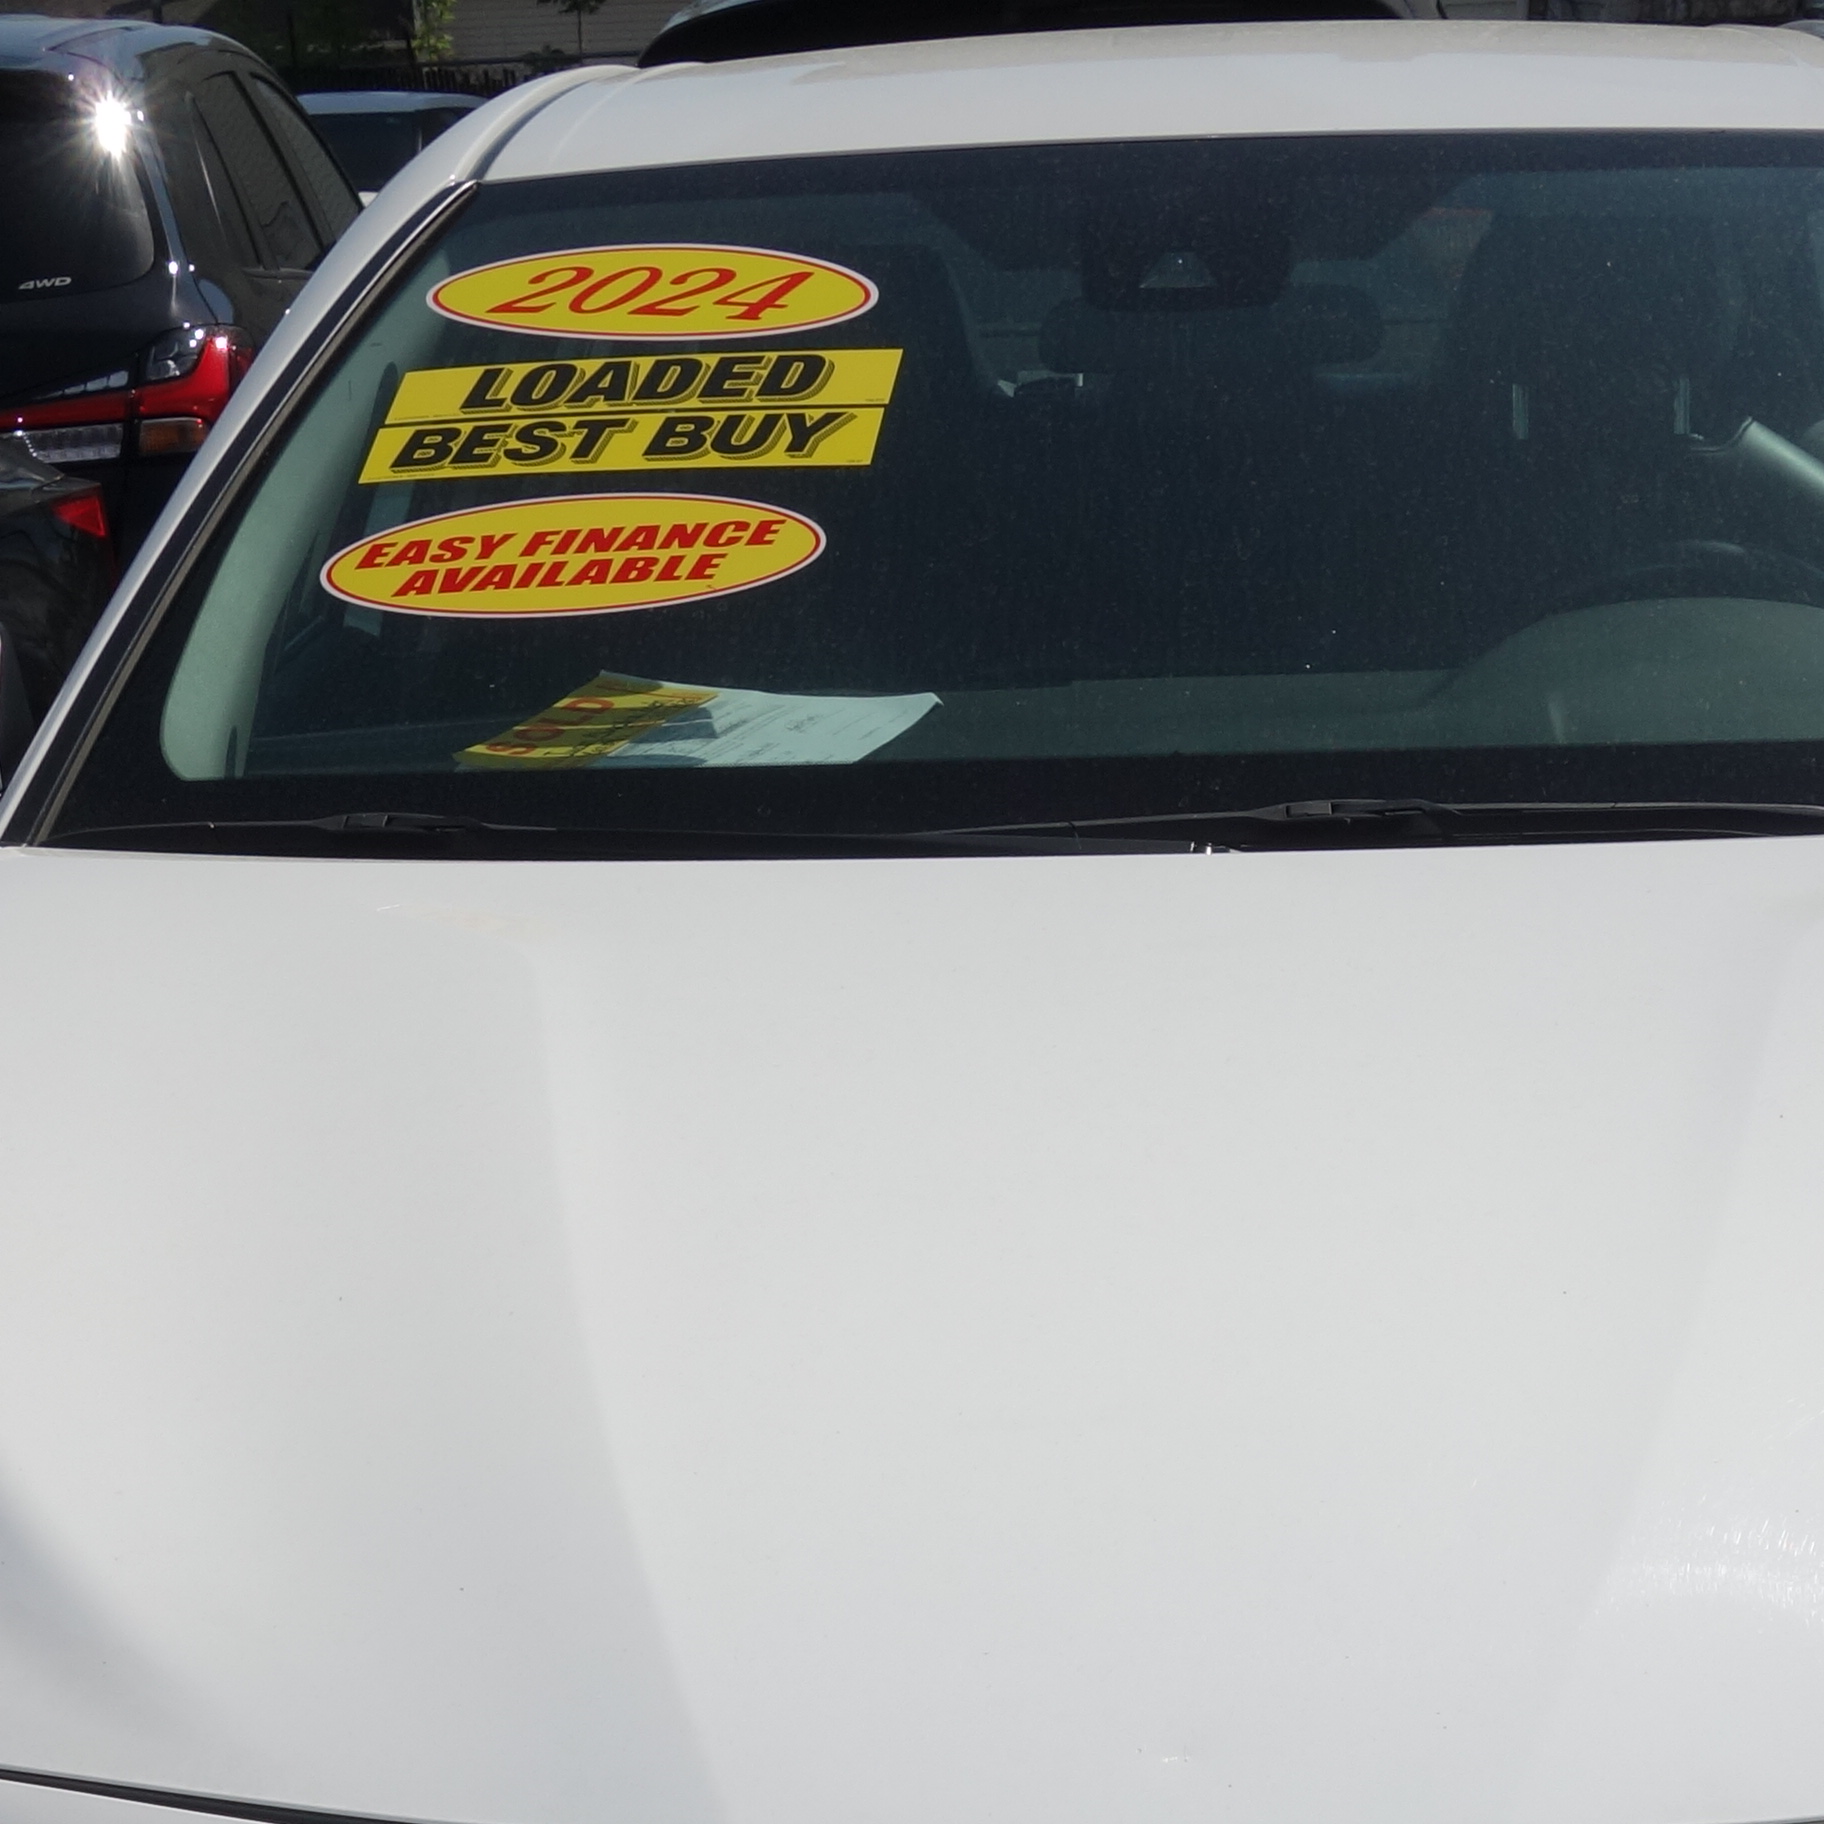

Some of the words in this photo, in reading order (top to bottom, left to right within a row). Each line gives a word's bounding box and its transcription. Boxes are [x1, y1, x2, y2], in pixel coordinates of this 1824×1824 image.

[18, 276, 72, 290] 4WD
[486, 266, 815, 321] 2024
[460, 353, 836, 411] LOADED
[390, 416, 637, 472] BEST
[643, 412, 855, 460] BUY
[356, 532, 515, 570] EASY
[521, 518, 786, 557] FINANCE
[394, 552, 727, 597] AVAILABLE
